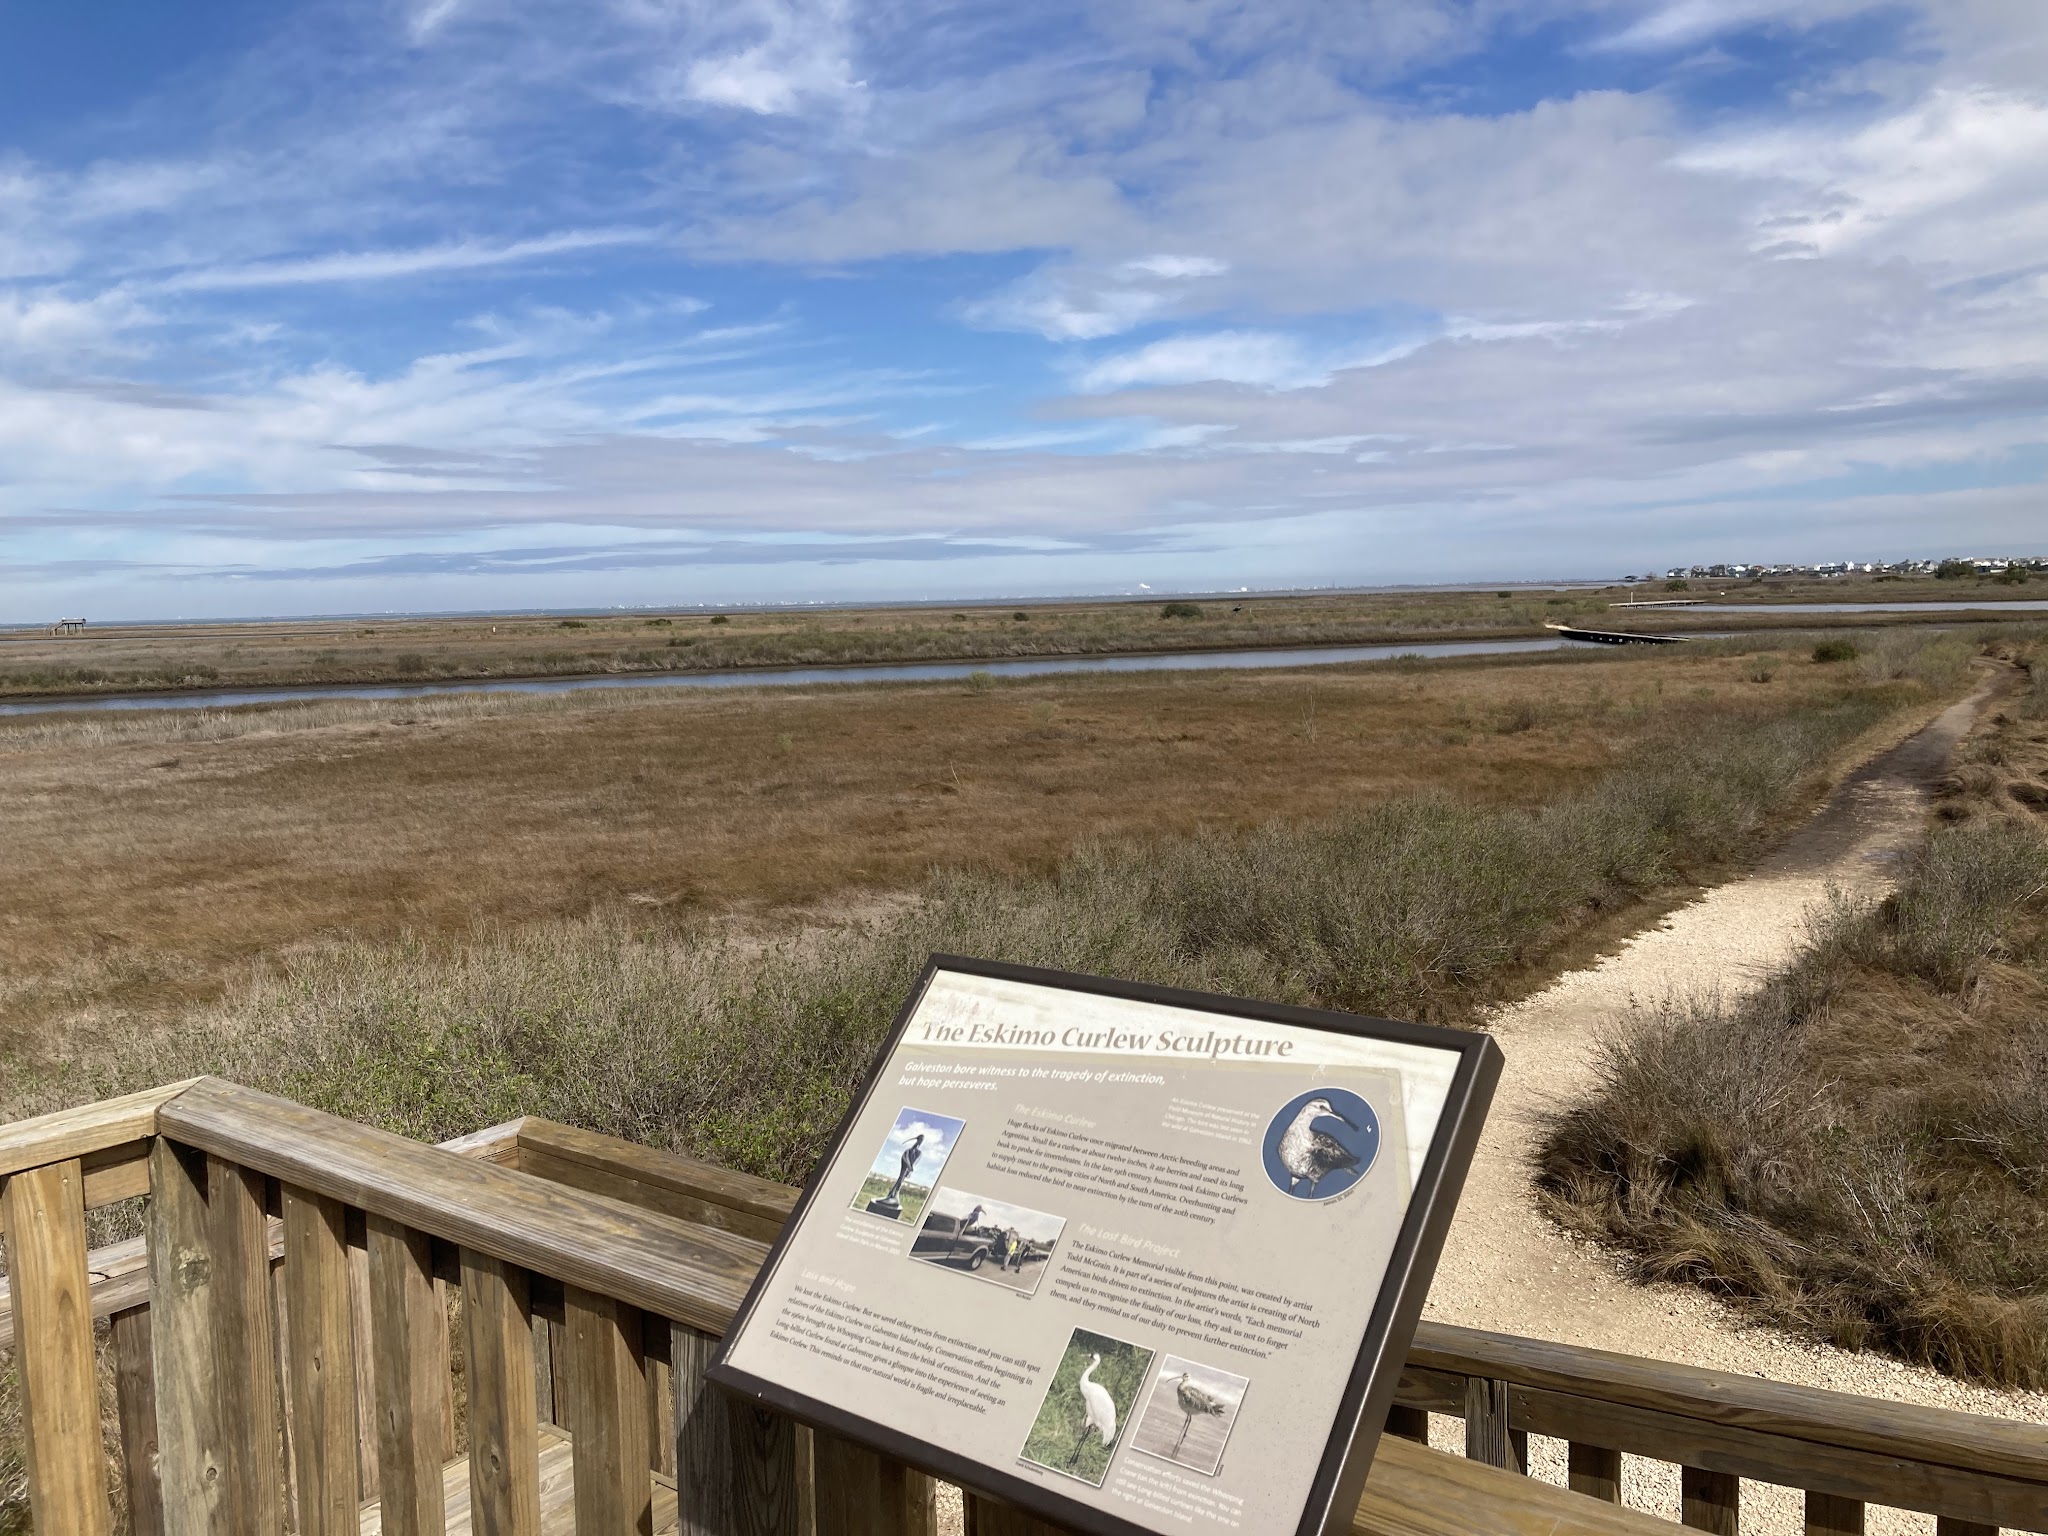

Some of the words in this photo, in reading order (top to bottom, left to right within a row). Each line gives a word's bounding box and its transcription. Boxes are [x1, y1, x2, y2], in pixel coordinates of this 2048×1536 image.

[922, 1022, 964, 1041] The
[968, 1024, 1056, 1047] Eskimo
[1061, 1027, 1150, 1050] Curlew
[1156, 1030, 1293, 1059] Sculpture
[897, 1074, 917, 1086] but
[916, 1075, 942, 1088] hope
[940, 1079, 998, 1091] perseveres.
[904, 1061, 953, 1073] Galveston
[952, 1063, 977, 1074] bore
[978, 1065, 1017, 1076] witness
[1017, 1067, 1030, 1077] to
[1031, 1067, 1050, 1078] the
[1050, 1068, 1093, 1082] tragedy
[1093, 1070, 1109, 1082] of
[1107, 1071, 1165, 1086] extinction,
[1014, 1103, 1031, 1115] The
[1030, 1106, 1063, 1122] Eskimo
[1063, 1113, 1097, 1128] Curlew
[1039, 1125, 1048, 1133] of
[1046, 1127, 1068, 1138] Eskimo
[1068, 1131, 1089, 1142] Curlew
[1089, 1138, 1104, 1146] once
[1104, 1141, 1133, 1152] migrated
[1132, 1145, 1159, 1158] between
[1158, 1152, 1179, 1162] Arctic
[1179, 1155, 1208, 1171] breeding
[1208, 1164, 1226, 1173] areas
[1225, 1168, 1241, 1176] and
[1006, 1166, 1018, 1175] loss
[1017, 1170, 1043, 1181] reduced
[1041, 1175, 1052, 1184] the
[1051, 1177, 1066, 1187] bird
[1072, 1184, 1087, 1192] near
[1086, 1187, 1118, 1200] extinction
[1118, 1193, 1127, 1204] by
[1126, 1196, 1139, 1205] the
[1138, 1199, 1153, 1209] turn
[1161, 1204, 1173, 1214] the
[1078, 1222, 1097, 1236] The
[1096, 1227, 1119, 1242] Lost
[1119, 1233, 1143, 1248] Bird
[1141, 1239, 1181, 1259] Project
[1060, 1264, 1091, 1279] American
[1091, 1272, 1108, 1284] birds
[1108, 1277, 1130, 1290] driven
[1129, 1284, 1138, 1292] to
[1137, 1287, 1172, 1302] extinction.
[1174, 1295, 1183, 1305] In
[1183, 1298, 1196, 1309] the
[1220, 1310, 1242, 1323] words,
[1265, 1323, 1303, 1339] memorial
[1066, 1251, 1084, 1263] Todd
[1082, 1256, 1111, 1271] McGrain.
[1112, 1264, 1119, 1273] It
[1119, 1266, 1126, 1275] is
[1124, 1270, 1140, 1279] part
[1140, 1273, 1150, 1281] of
[1153, 1277, 1173, 1288] series
[1172, 1282, 1183, 1290] of
[1181, 1285, 1217, 1300] sculptures
[1217, 1294, 1230, 1304] the
[1229, 1299, 1249, 1309] artist
[1249, 1302, 1257, 1311] is
[1257, 1306, 1288, 1321] creating
[1287, 1313, 1298, 1322] of
[1297, 1315, 1320, 1328] North
[1072, 1239, 1084, 1249] The
[1084, 1243, 1108, 1256] Eskimo
[1108, 1250, 1132, 1262] Curlew
[1132, 1256, 1165, 1271] Memorial
[1164, 1265, 1187, 1277] visible
[1186, 1270, 1204, 1282] from
[1204, 1275, 1218, 1286] this
[1217, 1281, 1239, 1293] point,
[1241, 1287, 1255, 1296] was
[1254, 1291, 1283, 1303] created
[1282, 1296, 1293, 1308] by
[1292, 1301, 1313, 1312] artist
[1049, 1288, 1068, 1301] them,
[1068, 1296, 1083, 1304] and
[1082, 1298, 1097, 1311] they
[1096, 1304, 1122, 1316] remind
[1129, 1313, 1140, 1321] of
[1138, 1316, 1151, 1325] our
[1150, 1318, 1168, 1331] duty
[1167, 1324, 1176, 1332] to
[1174, 1327, 1203, 1341] prevent
[1203, 1333, 1229, 1348] further
[1055, 1278, 1081, 1290] compels
[1089, 1287, 1098, 1295] to
[1097, 1290, 1129, 1304] recognize
[1129, 1298, 1141, 1308] the
[1141, 1301, 1166, 1316] finality
[1165, 1309, 1175, 1317] of
[1173, 1312, 1187, 1320] our
[1186, 1313, 1202, 1326] loss,
[1203, 1319, 1220, 1332] they
[1219, 1325, 1232, 1334] ask
[1233, 1329, 1243, 1337] us
[1243, 1332, 1256, 1341] not
[1256, 1335, 1266, 1343] to
[1265, 1336, 1288, 1350] forget
[769, 1329, 789, 1343] Eskimo
[808, 1344, 821, 1354] This
[820, 1350, 843, 1362] reminds
[849, 1359, 862, 1369] that
[861, 1365, 873, 1373] our
[871, 1369, 894, 1381] natural
[893, 1376, 911, 1387] world
[909, 1380, 916, 1389] is
[915, 1382, 935, 1396] fragile
[934, 1391, 948, 1400] and
[946, 1394, 986, 1415] irreplaceable.
[823, 1335, 842, 1347] found
[846, 1343, 874, 1359] Galveston
[872, 1354, 888, 1364] gives
[890, 1360, 915, 1374] glimpse
[914, 1367, 927, 1378] into
[927, 1372, 938, 1382] the
[937, 1377, 970, 1393] experience
[969, 1388, 979, 1396] of
[976, 1391, 998, 1405] seeing
